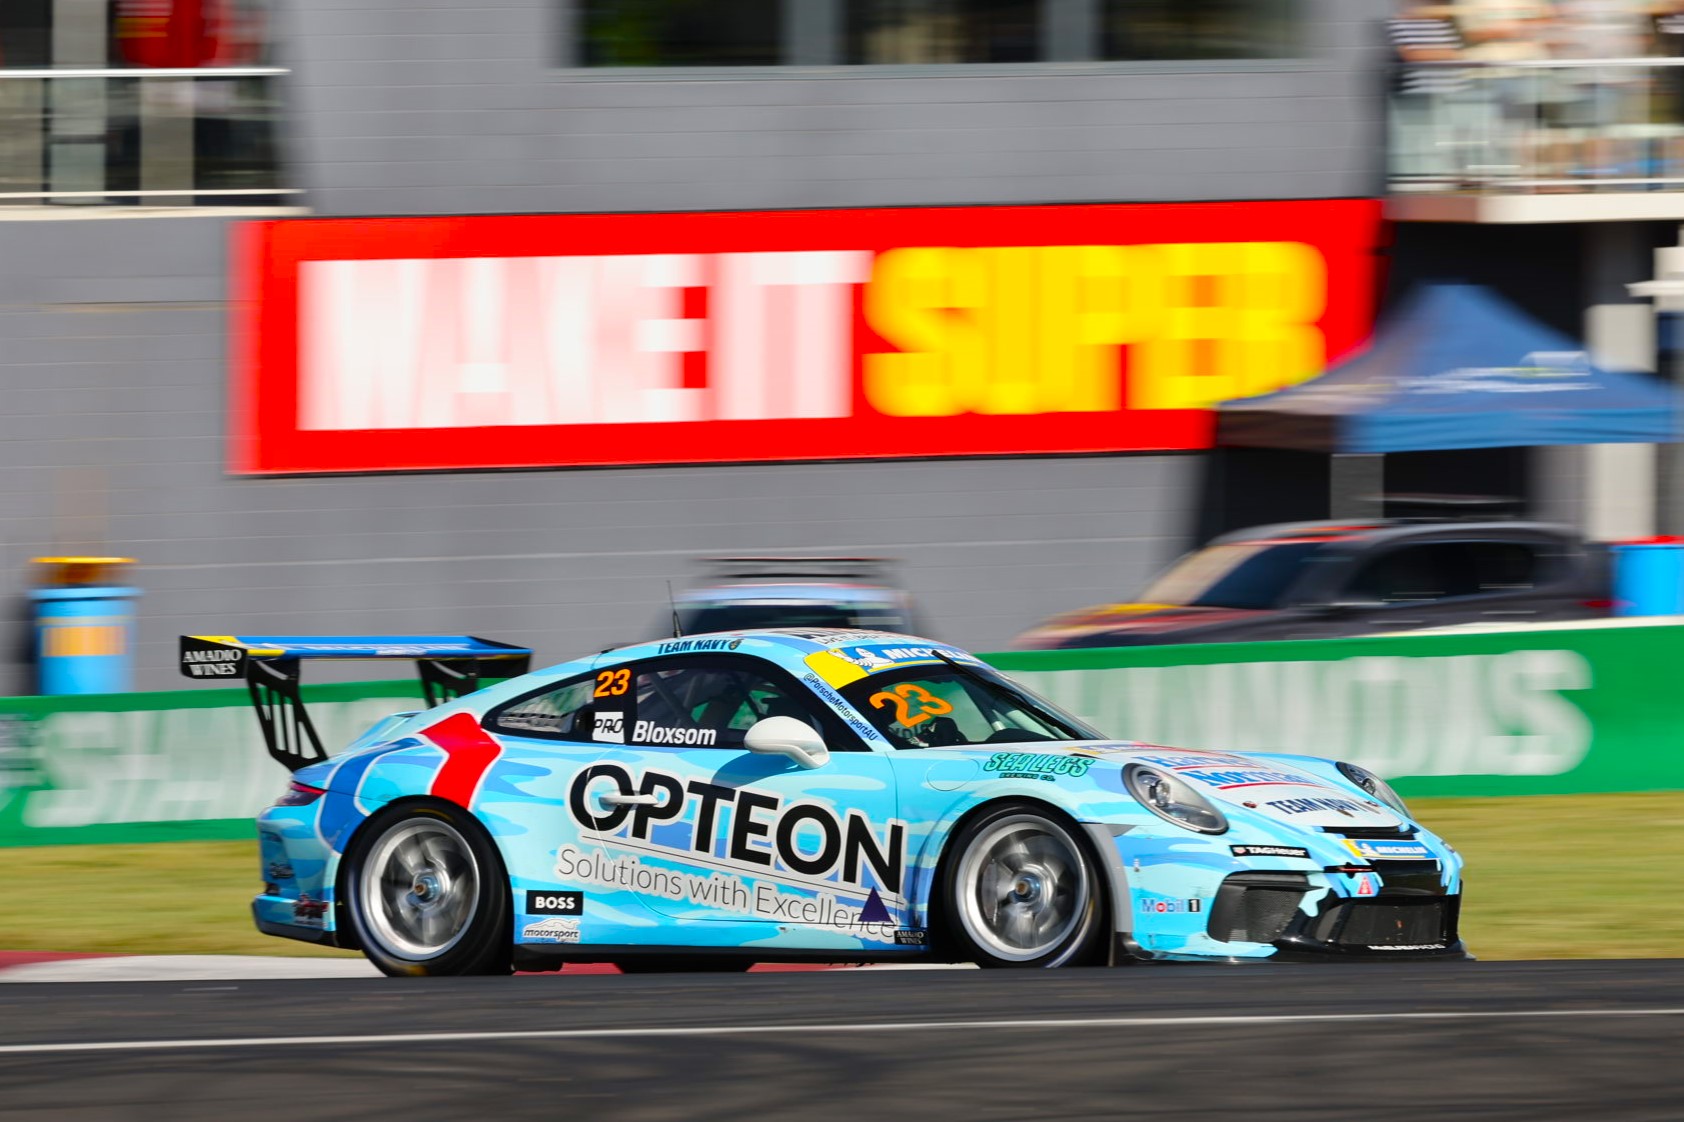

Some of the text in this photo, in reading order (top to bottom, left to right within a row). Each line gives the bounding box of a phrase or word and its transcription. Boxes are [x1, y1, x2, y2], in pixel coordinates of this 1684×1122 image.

[292, 241, 1328, 431] MAKE IT SUPER
[657, 638, 730, 654] TEAM NAVY
[182, 649, 243, 664] AMADIO
[188, 662, 237, 677] WINES
[593, 668, 632, 698] 23
[803, 672, 880, 742] @PorscheMotorsportAU
[869, 683, 954, 728] 23
[593, 718, 624, 734] PRO
[631, 720, 717, 746] Bloxsom
[1264, 797, 1328, 815] TEAM
[569, 763, 904, 894] OPTEON
[1375, 846, 1428, 854] MICHELIN
[558, 848, 682, 896] Solutions
[688, 876, 747, 908] with
[534, 896, 576, 910] BOSS
[1142, 899, 1185, 913] Mobil
[523, 929, 579, 941] motorsport
